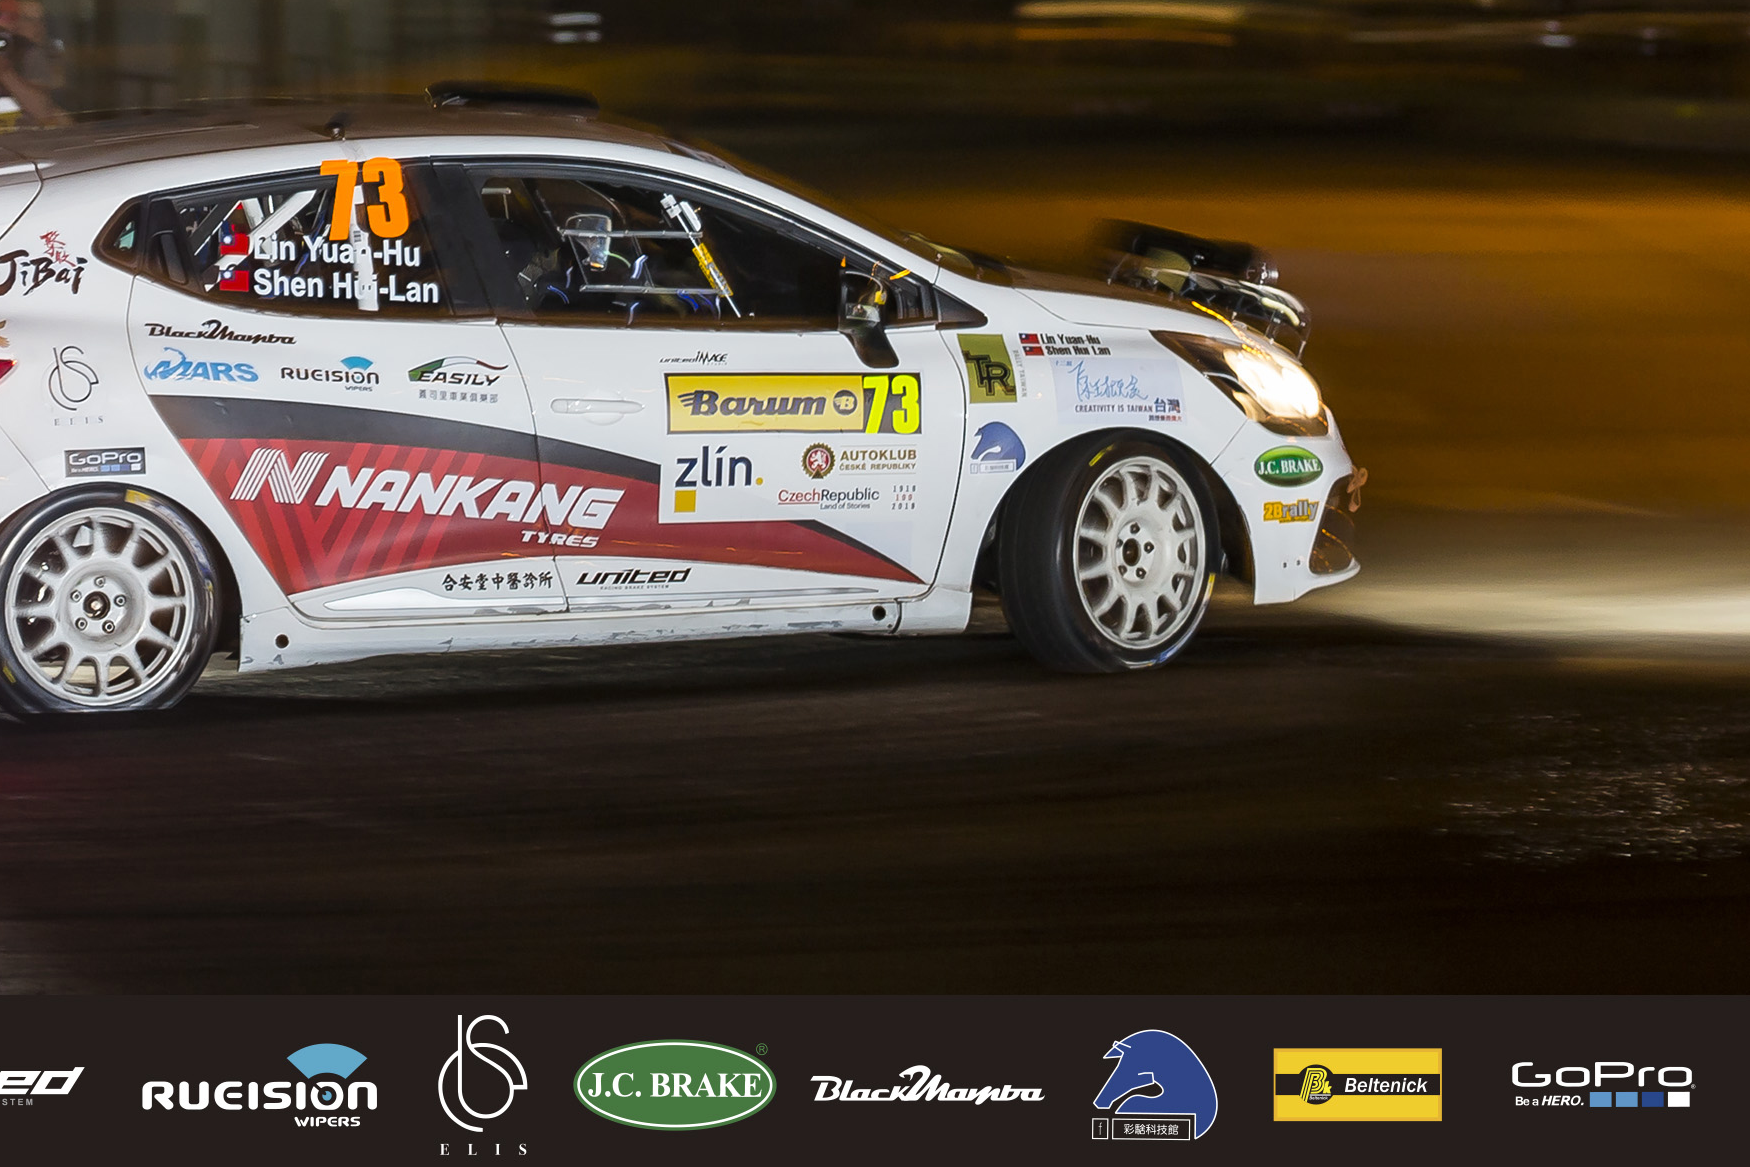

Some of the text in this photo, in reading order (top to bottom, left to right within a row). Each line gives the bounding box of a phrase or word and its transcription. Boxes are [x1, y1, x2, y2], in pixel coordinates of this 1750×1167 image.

[320, 157, 410, 241] 73
[254, 233, 296, 261] Lin
[253, 268, 324, 298] Shen
[1040, 333, 1056, 345] Lin
[1045, 345, 1111, 356] Shen Hui Lan
[144, 359, 259, 382] MARS
[416, 370, 501, 386] EASILY
[678, 389, 827, 416] Barum
[863, 375, 920, 434] 73
[1075, 404, 1115, 413] CREATIVITY
[1127, 404, 1153, 413] TAIWAN
[68, 451, 142, 466] GoPro
[840, 449, 917, 461] AUTOKLUB
[839, 462, 917, 471] ČESKÉ REPUBLIKY
[1258, 458, 1321, 475] J.C. BRAKE
[315, 465, 626, 530] NANKANG
[520, 529, 601, 549] TYRES
[576, 568, 692, 585] united
